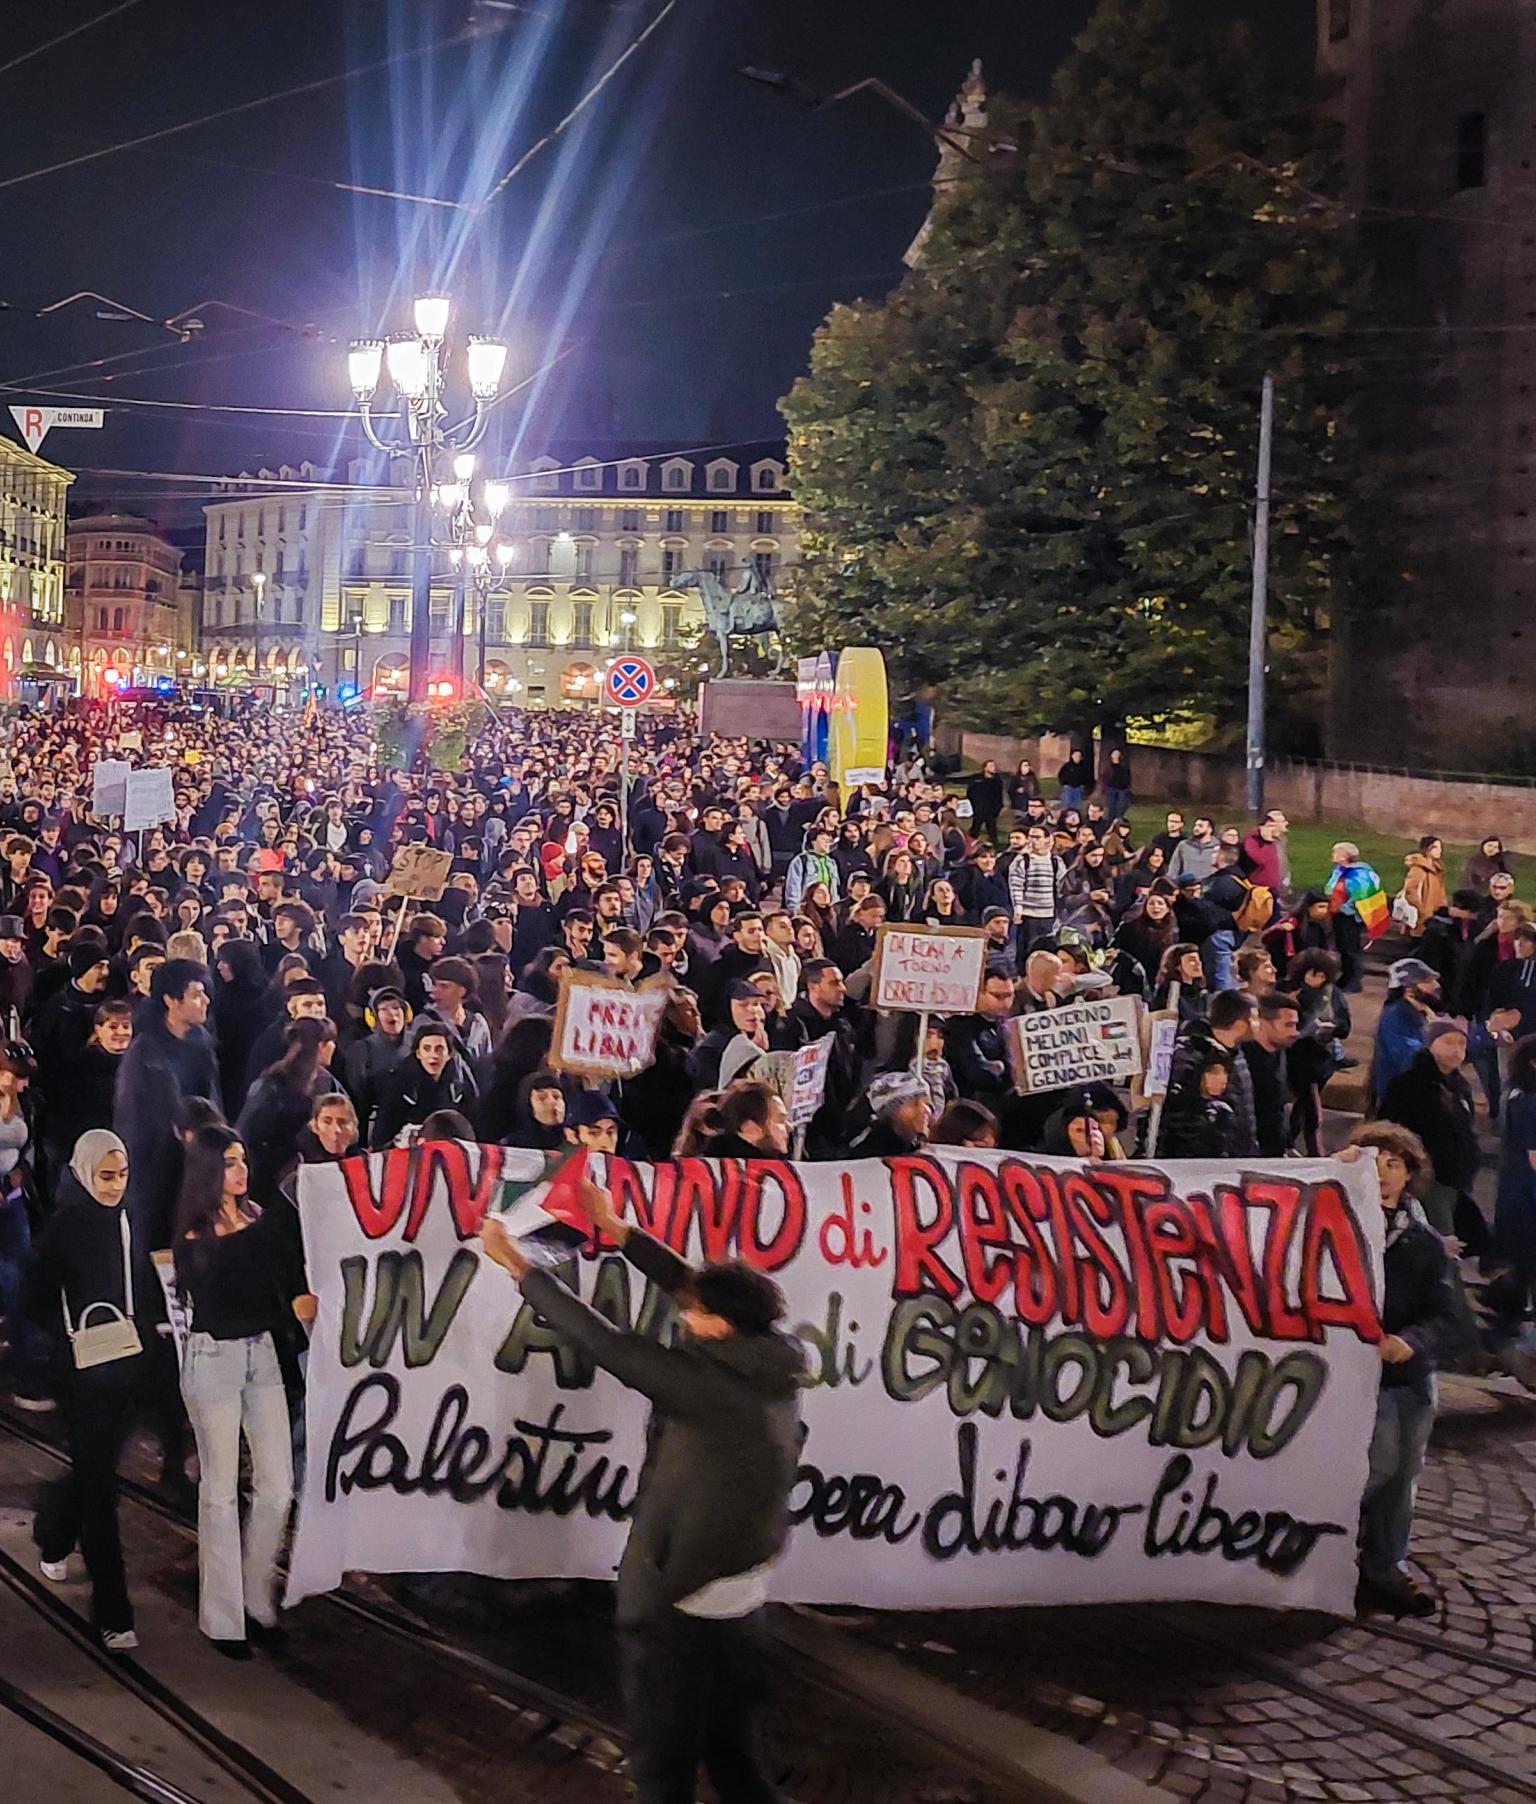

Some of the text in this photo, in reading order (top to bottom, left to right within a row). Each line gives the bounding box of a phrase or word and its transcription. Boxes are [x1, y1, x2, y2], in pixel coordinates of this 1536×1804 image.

[25, 409, 43, 438] R
[57, 413, 94, 423] CONTINUA
[1025, 1005, 1112, 1032] GOVERNO
[1026, 1027, 1090, 1052] MELONI
[1027, 1045, 1105, 1071] COMPLICE
[1031, 1062, 1117, 1088] GENOCIDIO
[340, 1139, 505, 1243] UN
[819, 1171, 889, 1269] di
[324, 1372, 640, 1523] Palestin
